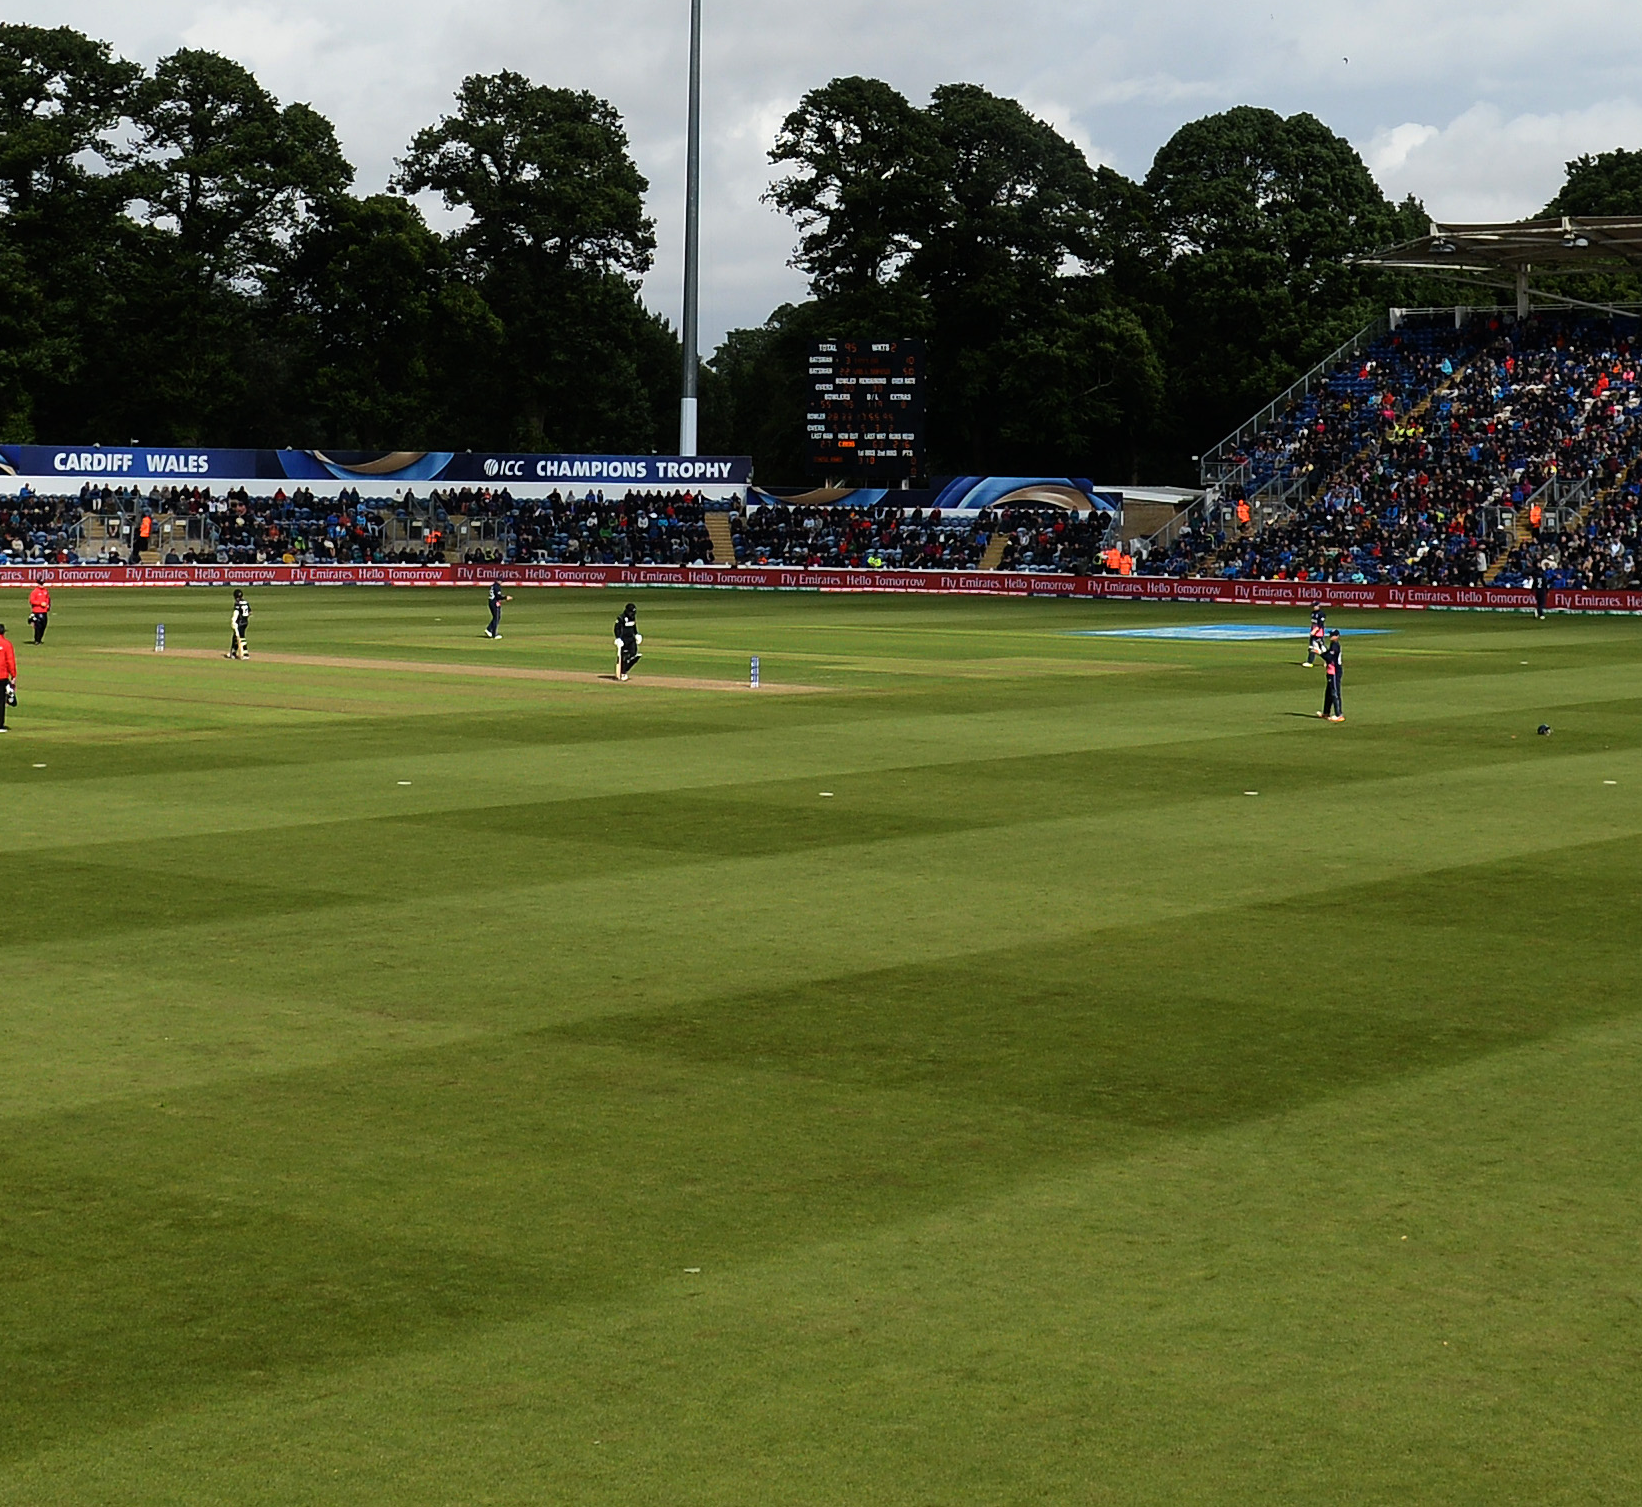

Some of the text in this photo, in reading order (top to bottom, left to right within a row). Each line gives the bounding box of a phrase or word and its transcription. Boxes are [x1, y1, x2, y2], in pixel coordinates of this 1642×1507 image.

[53, 453, 209, 473] CARDIFF WALES
[500, 460, 732, 478] ICC CHAMPIONS TROPHY
[29, 569, 54, 581] Hello
[58, 569, 110, 581] Tomorrow
[126, 569, 142, 583] Fly
[195, 569, 220, 580] Hello
[224, 569, 275, 580] Tomorrow
[291, 569, 306, 583] Fly
[360, 570, 385, 580] Hello
[387, 570, 442, 580] Tomorrow
[458, 569, 472, 583] Fly
[526, 569, 551, 580] Hello
[555, 570, 605, 581] Tomorrow
[621, 571, 636, 584] Fly
[690, 572, 714, 582] Hello
[717, 573, 766, 583] Tomorrow
[781, 574, 796, 587] Fly
[847, 575, 871, 585] Hello
[875, 576, 926, 586] Tomorrow
[941, 577, 956, 590] Fly
[1005, 578, 1027, 589] Hello
[1031, 579, 1075, 590] Tomorrow
[1088, 580, 1101, 594] Fly
[1148, 582, 1170, 593] Hello
[1173, 583, 1221, 594] Tomorrow
[1235, 585, 1249, 599] Fly
[1298, 587, 1322, 598] Hello
[1325, 588, 1374, 600] Tomorrow
[1389, 589, 1403, 604] Fly
[1457, 591, 1482, 603] Hello
[1555, 593, 1571, 608] Fly
